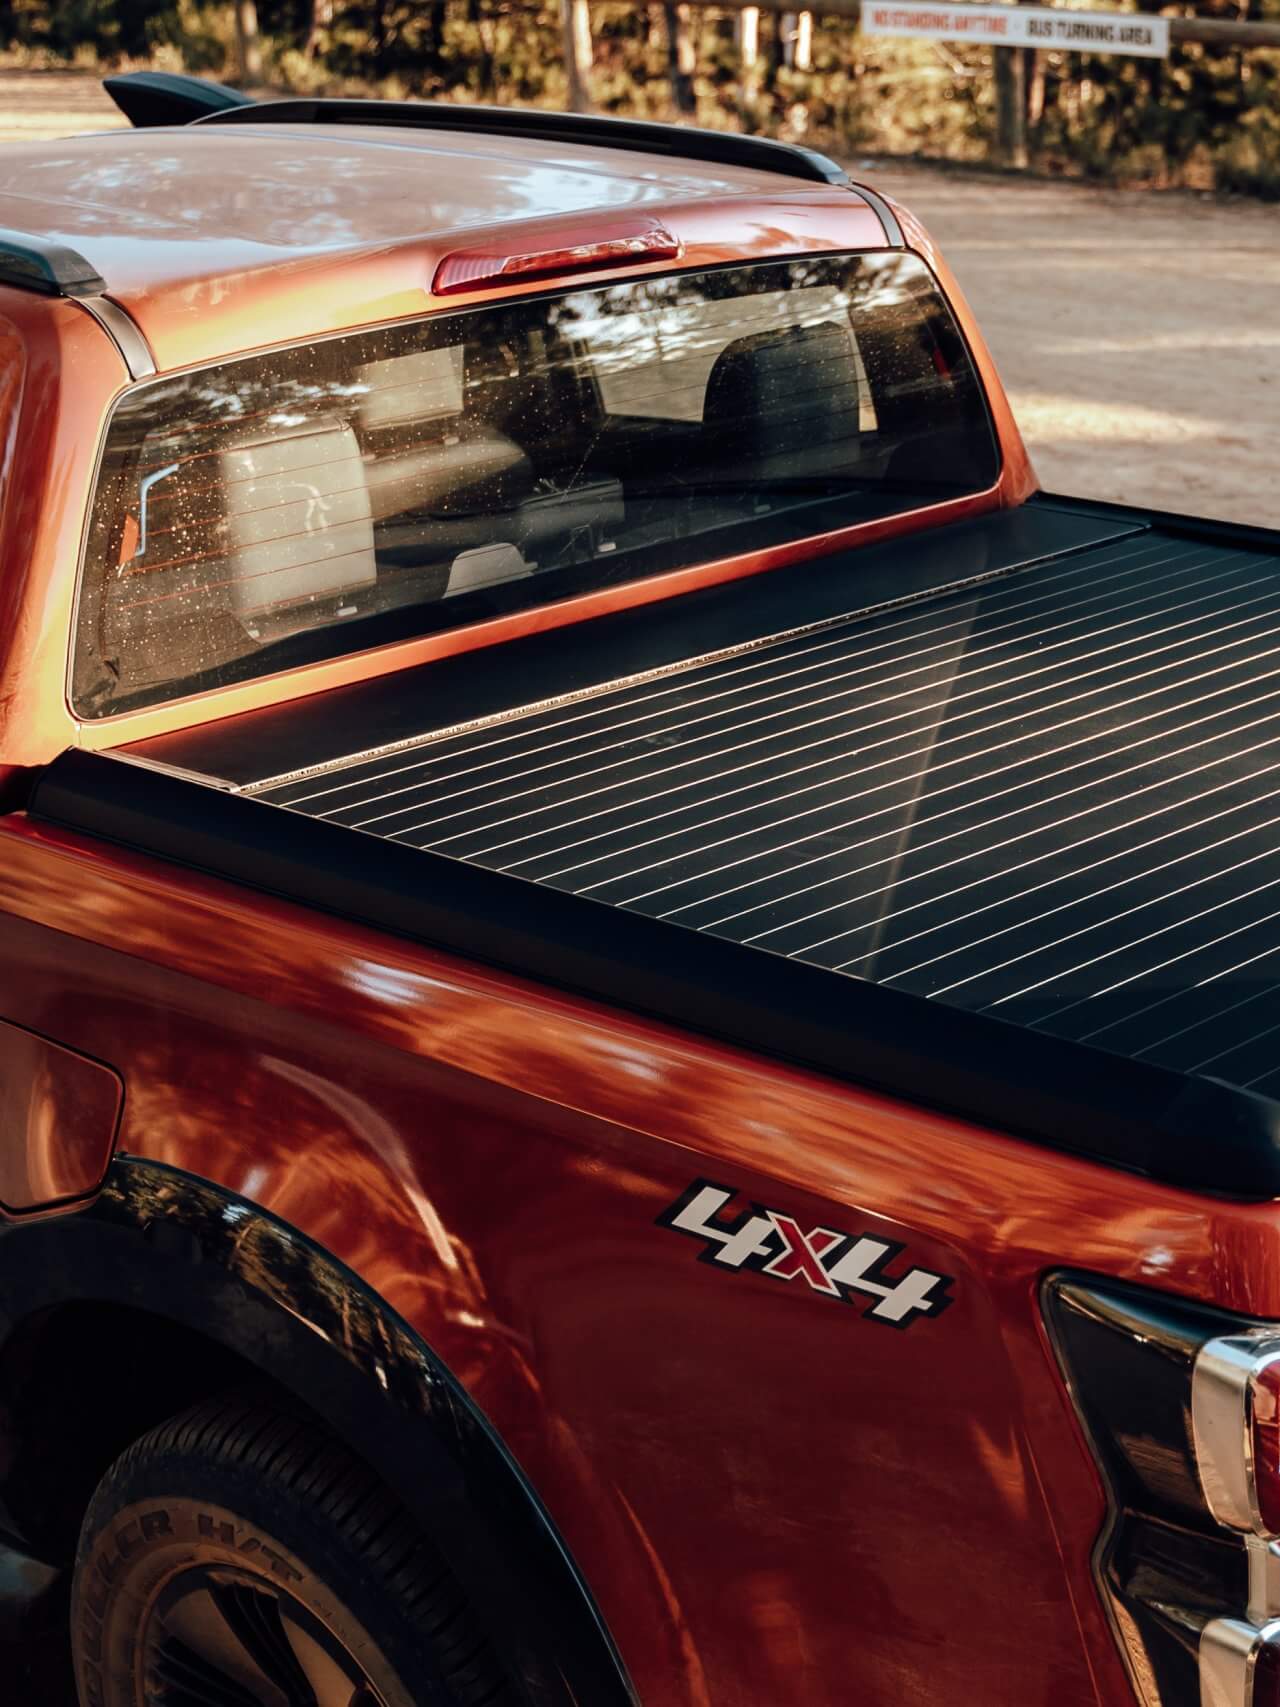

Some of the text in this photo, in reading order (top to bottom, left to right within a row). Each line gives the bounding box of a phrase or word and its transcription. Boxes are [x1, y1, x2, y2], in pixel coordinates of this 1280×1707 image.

[873, 10, 1153, 45] NO STANDING ANYTIME BUS TURNING AREA
